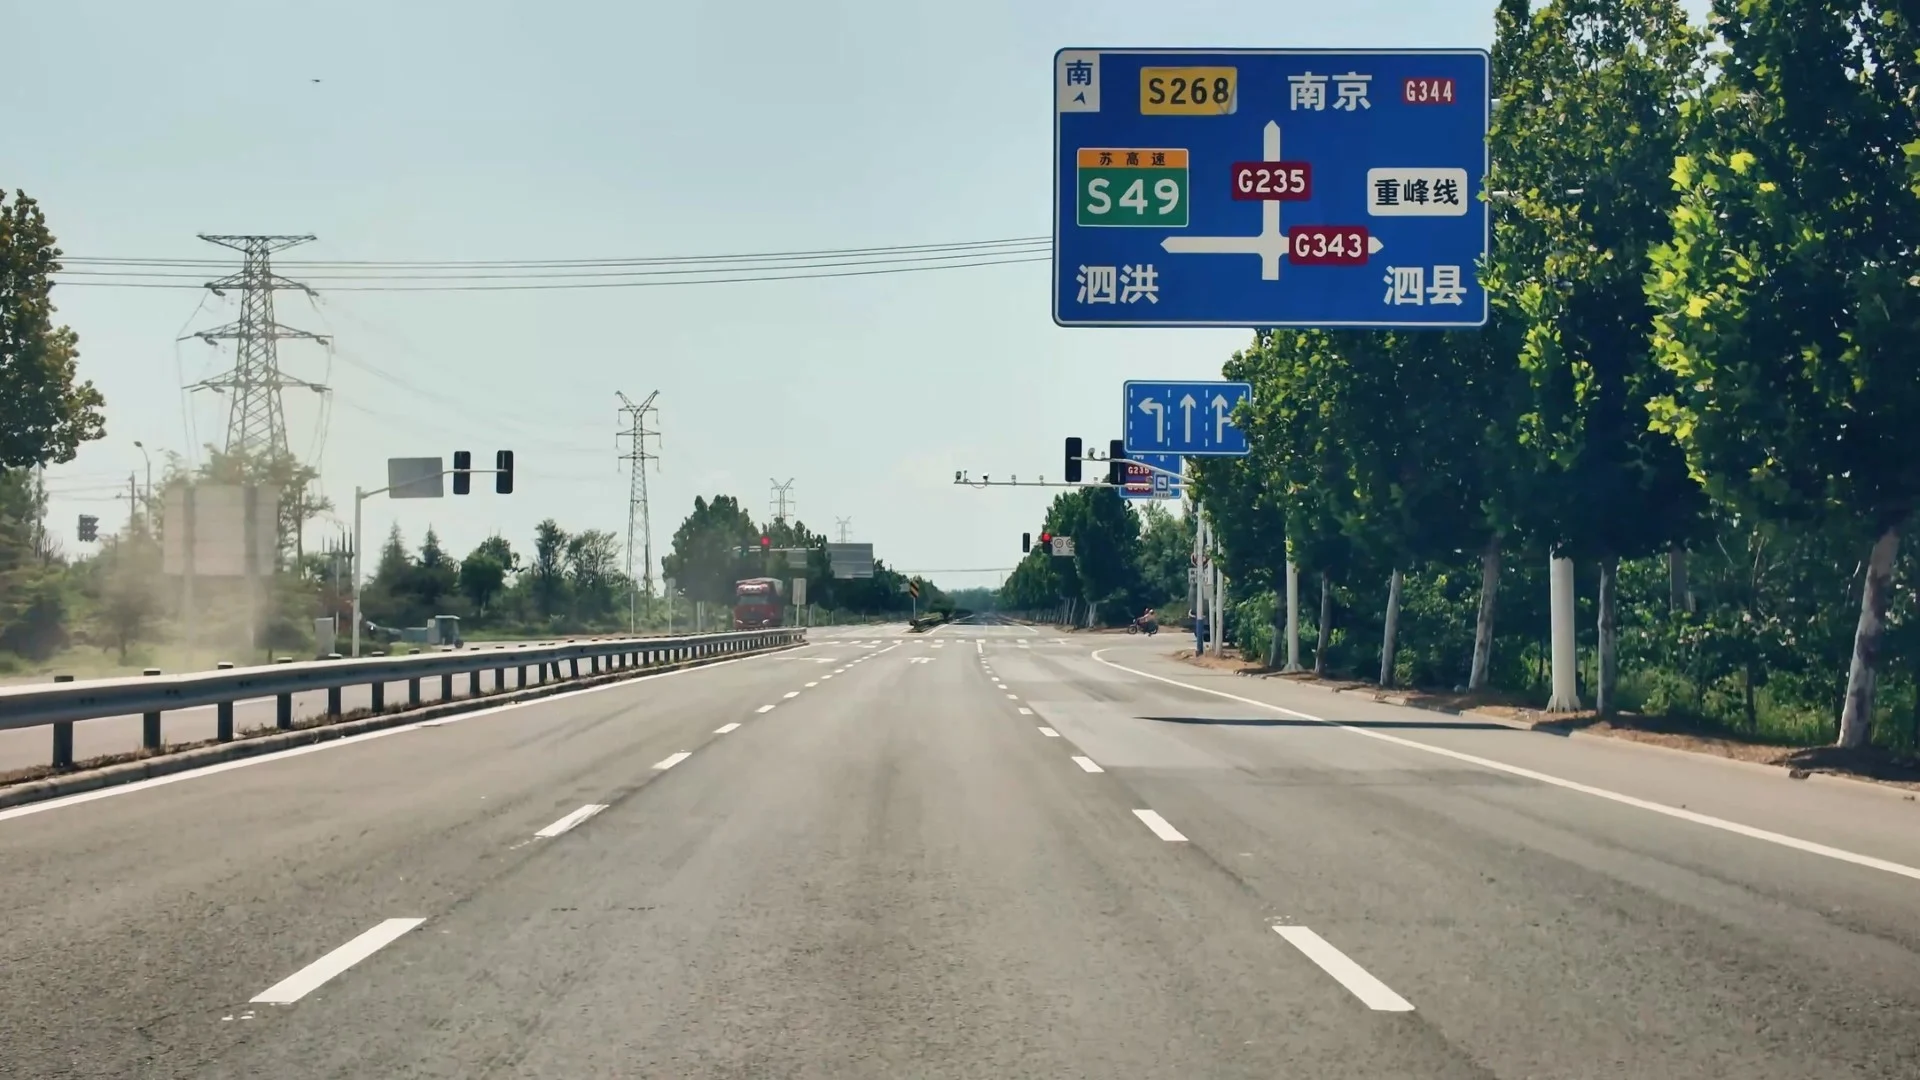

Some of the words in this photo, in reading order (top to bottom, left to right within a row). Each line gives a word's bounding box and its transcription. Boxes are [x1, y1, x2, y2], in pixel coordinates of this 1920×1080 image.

[1066, 60, 1093, 86] 南
[1149, 78, 1229, 104] S268
[1288, 71, 1372, 111] 南京
[1406, 80, 1452, 102] G344
[1100, 152, 1165, 166] 苏高速
[1238, 169, 1305, 193] G235
[1375, 179, 1459, 206] 重峰线
[1087, 178, 1179, 215] S49
[1295, 233, 1362, 257] G343
[1076, 264, 1159, 304] 泗洪
[1384, 265, 1467, 306] 泗县
